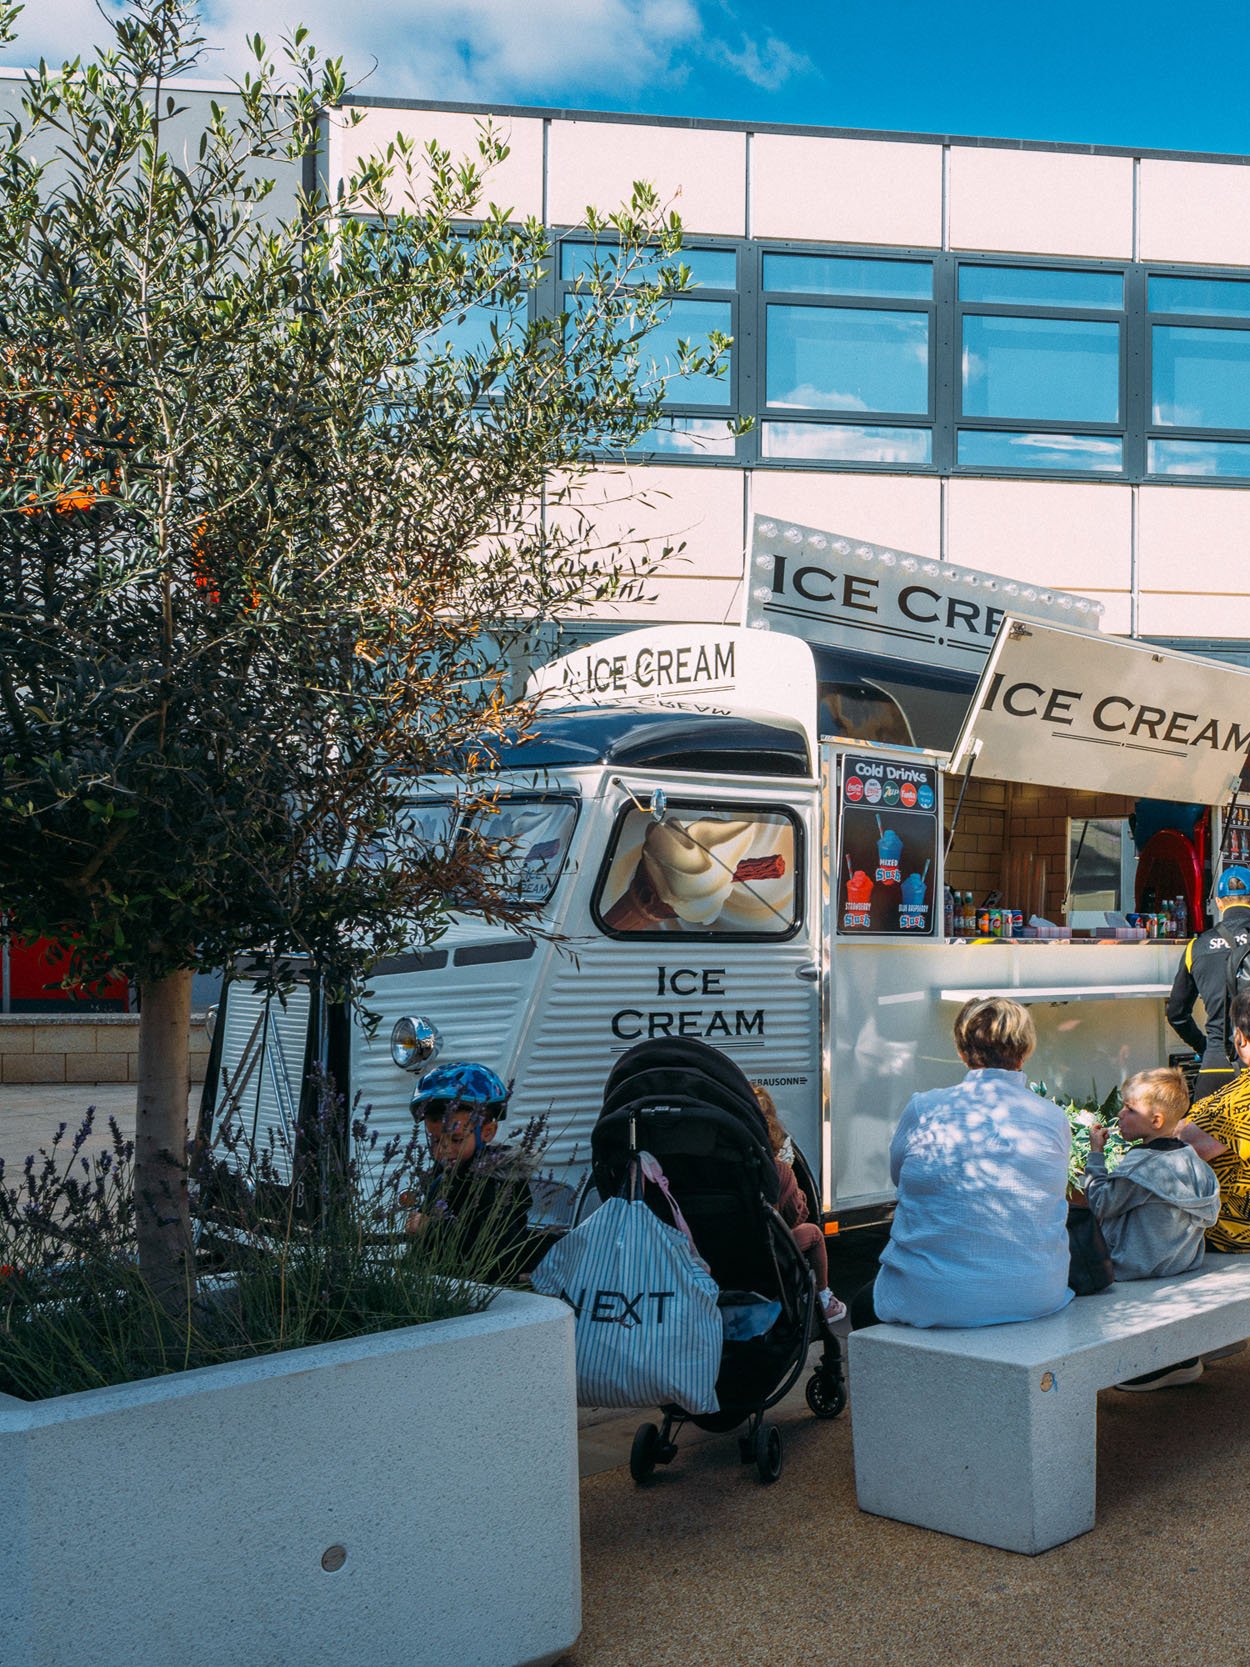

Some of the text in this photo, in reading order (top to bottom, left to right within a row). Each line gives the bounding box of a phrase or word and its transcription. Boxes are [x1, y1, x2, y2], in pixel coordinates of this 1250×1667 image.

[771, 554, 880, 614] ICE
[586, 641, 736, 693] ICE CREAM
[980, 672, 1083, 727] ICE
[855, 762, 928, 783] Cold Drinks
[879, 859, 898, 867] MIXED
[656, 966, 726, 996] ICE
[611, 1008, 765, 1040] CREAM
[559, 1288, 675, 1325] NEXT
